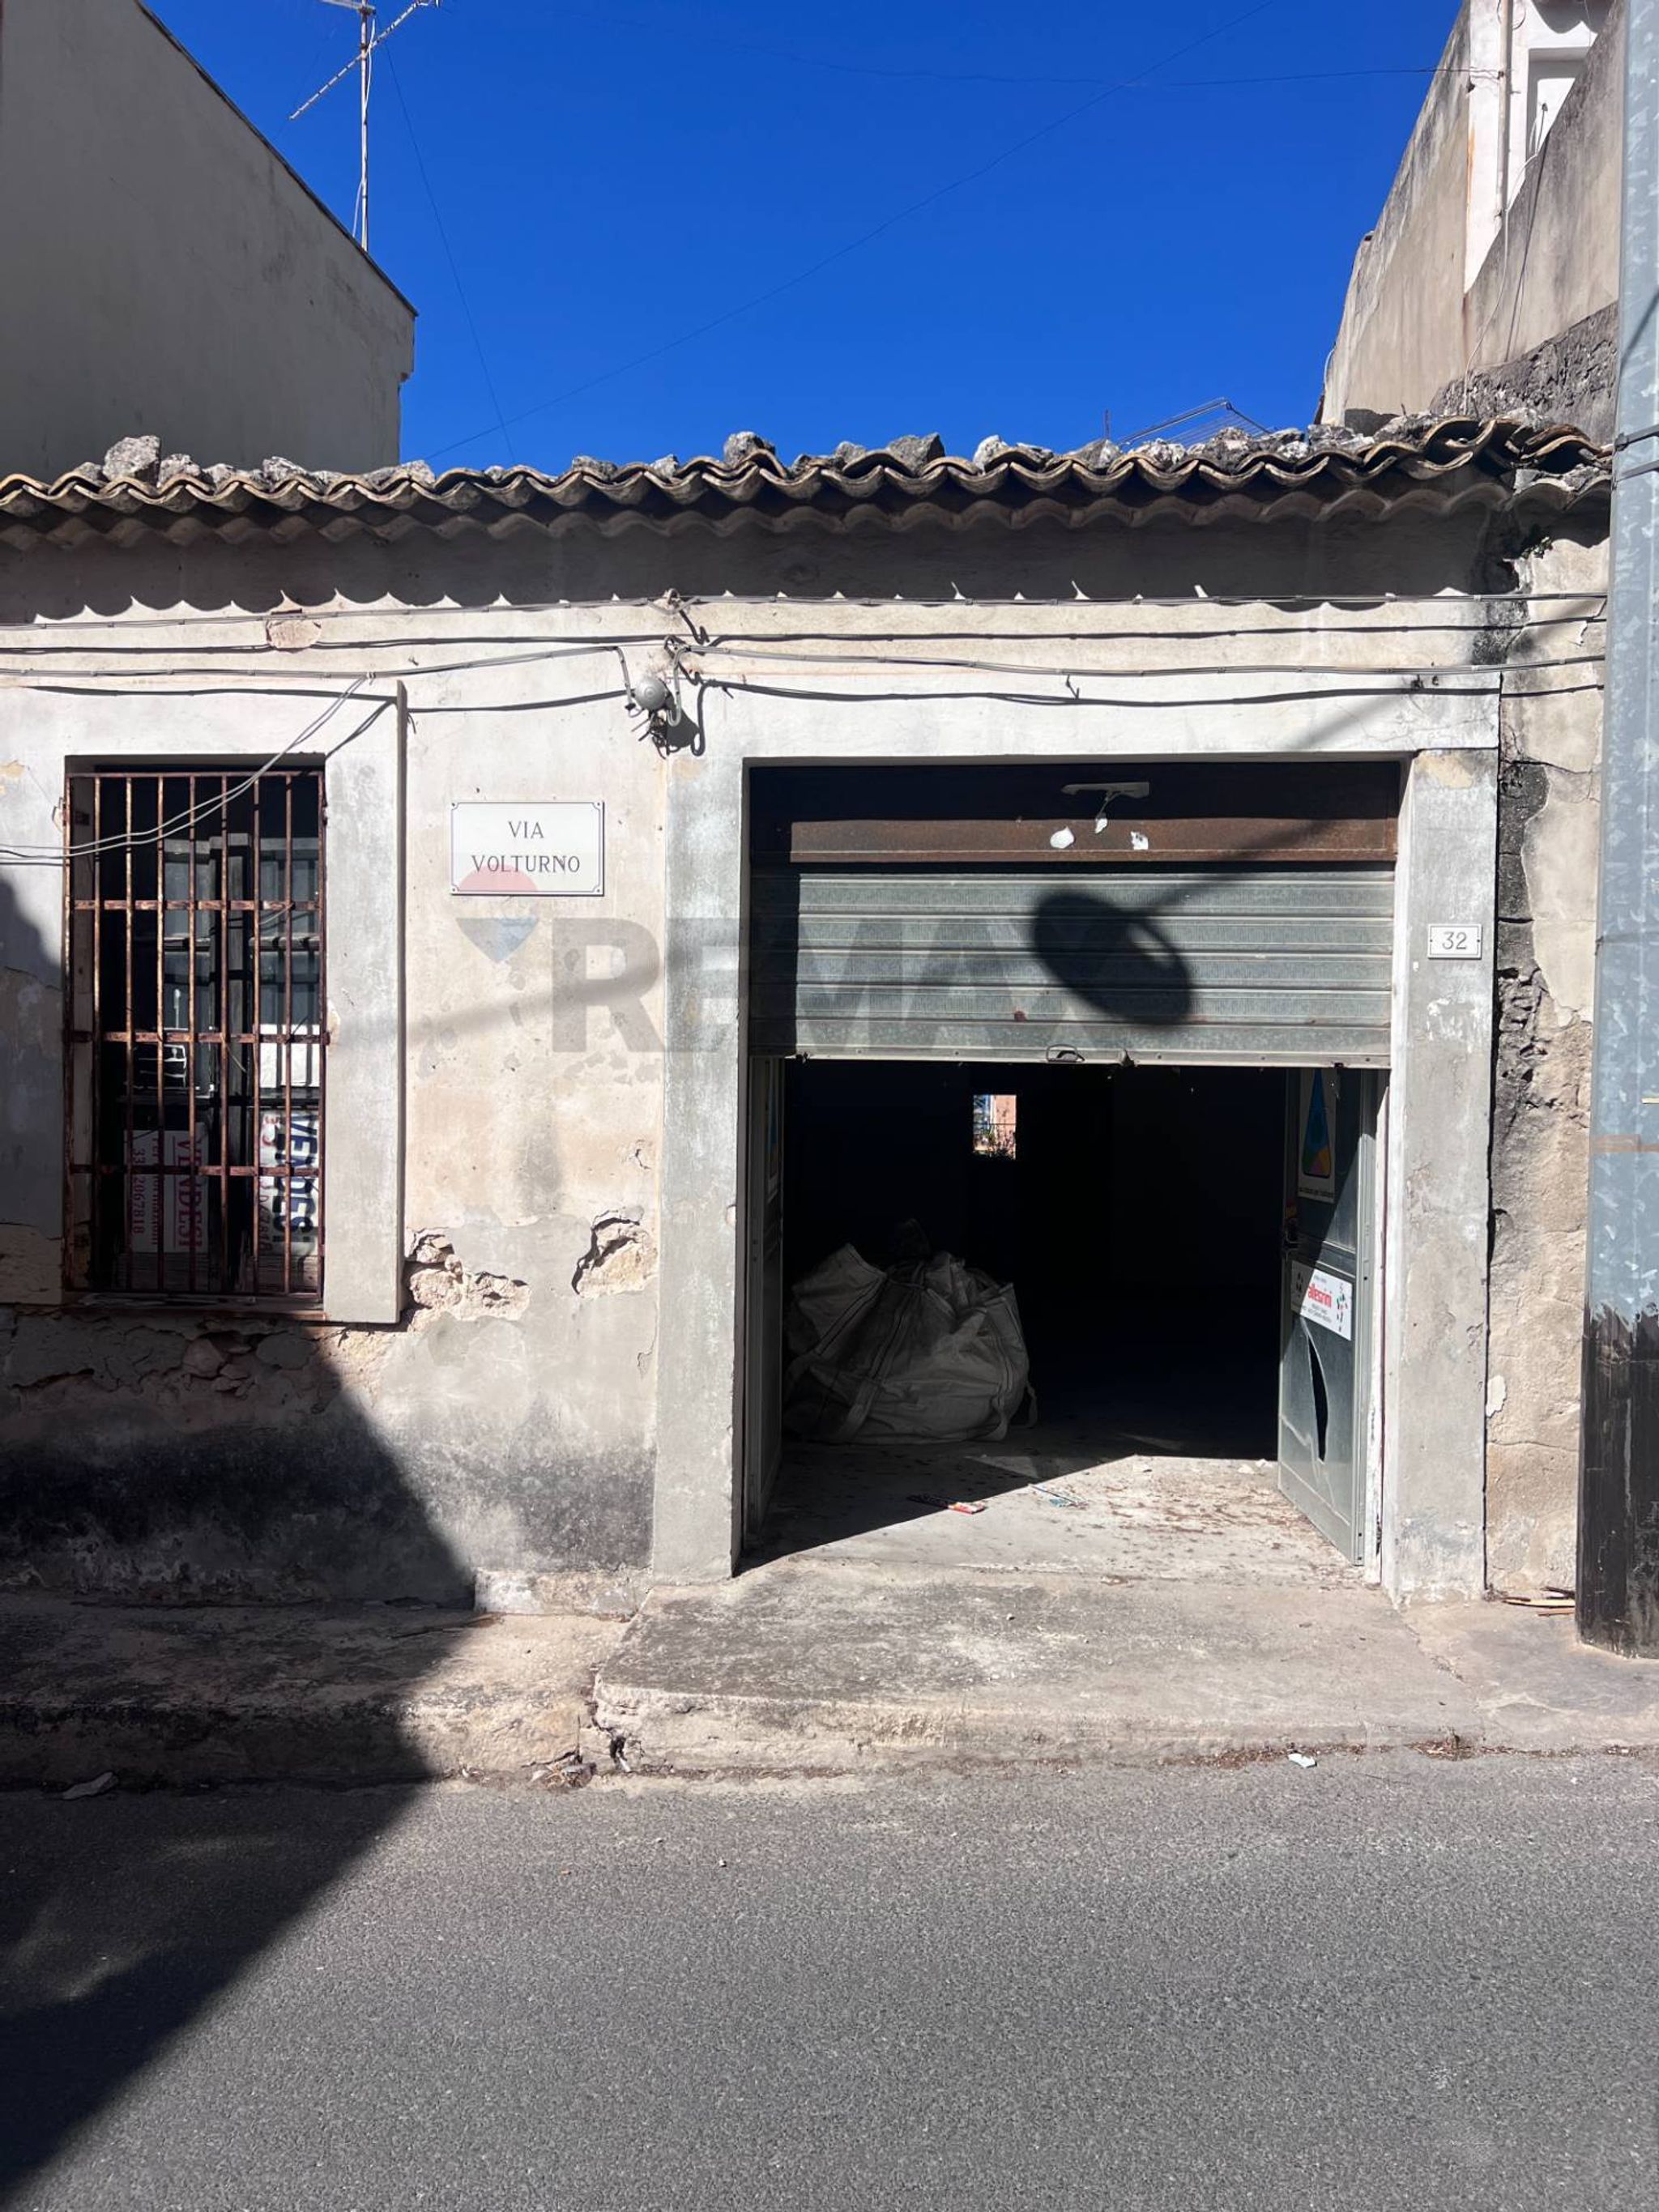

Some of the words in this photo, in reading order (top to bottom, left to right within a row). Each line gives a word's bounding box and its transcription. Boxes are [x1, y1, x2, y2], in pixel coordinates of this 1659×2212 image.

[508, 821, 544, 838] VIA
[471, 855, 581, 872] VOLTURNO
[1442, 931, 1467, 950] 32
[273, 1114, 318, 1243] VENDESI
[177, 1136, 203, 1248] VENDESI
